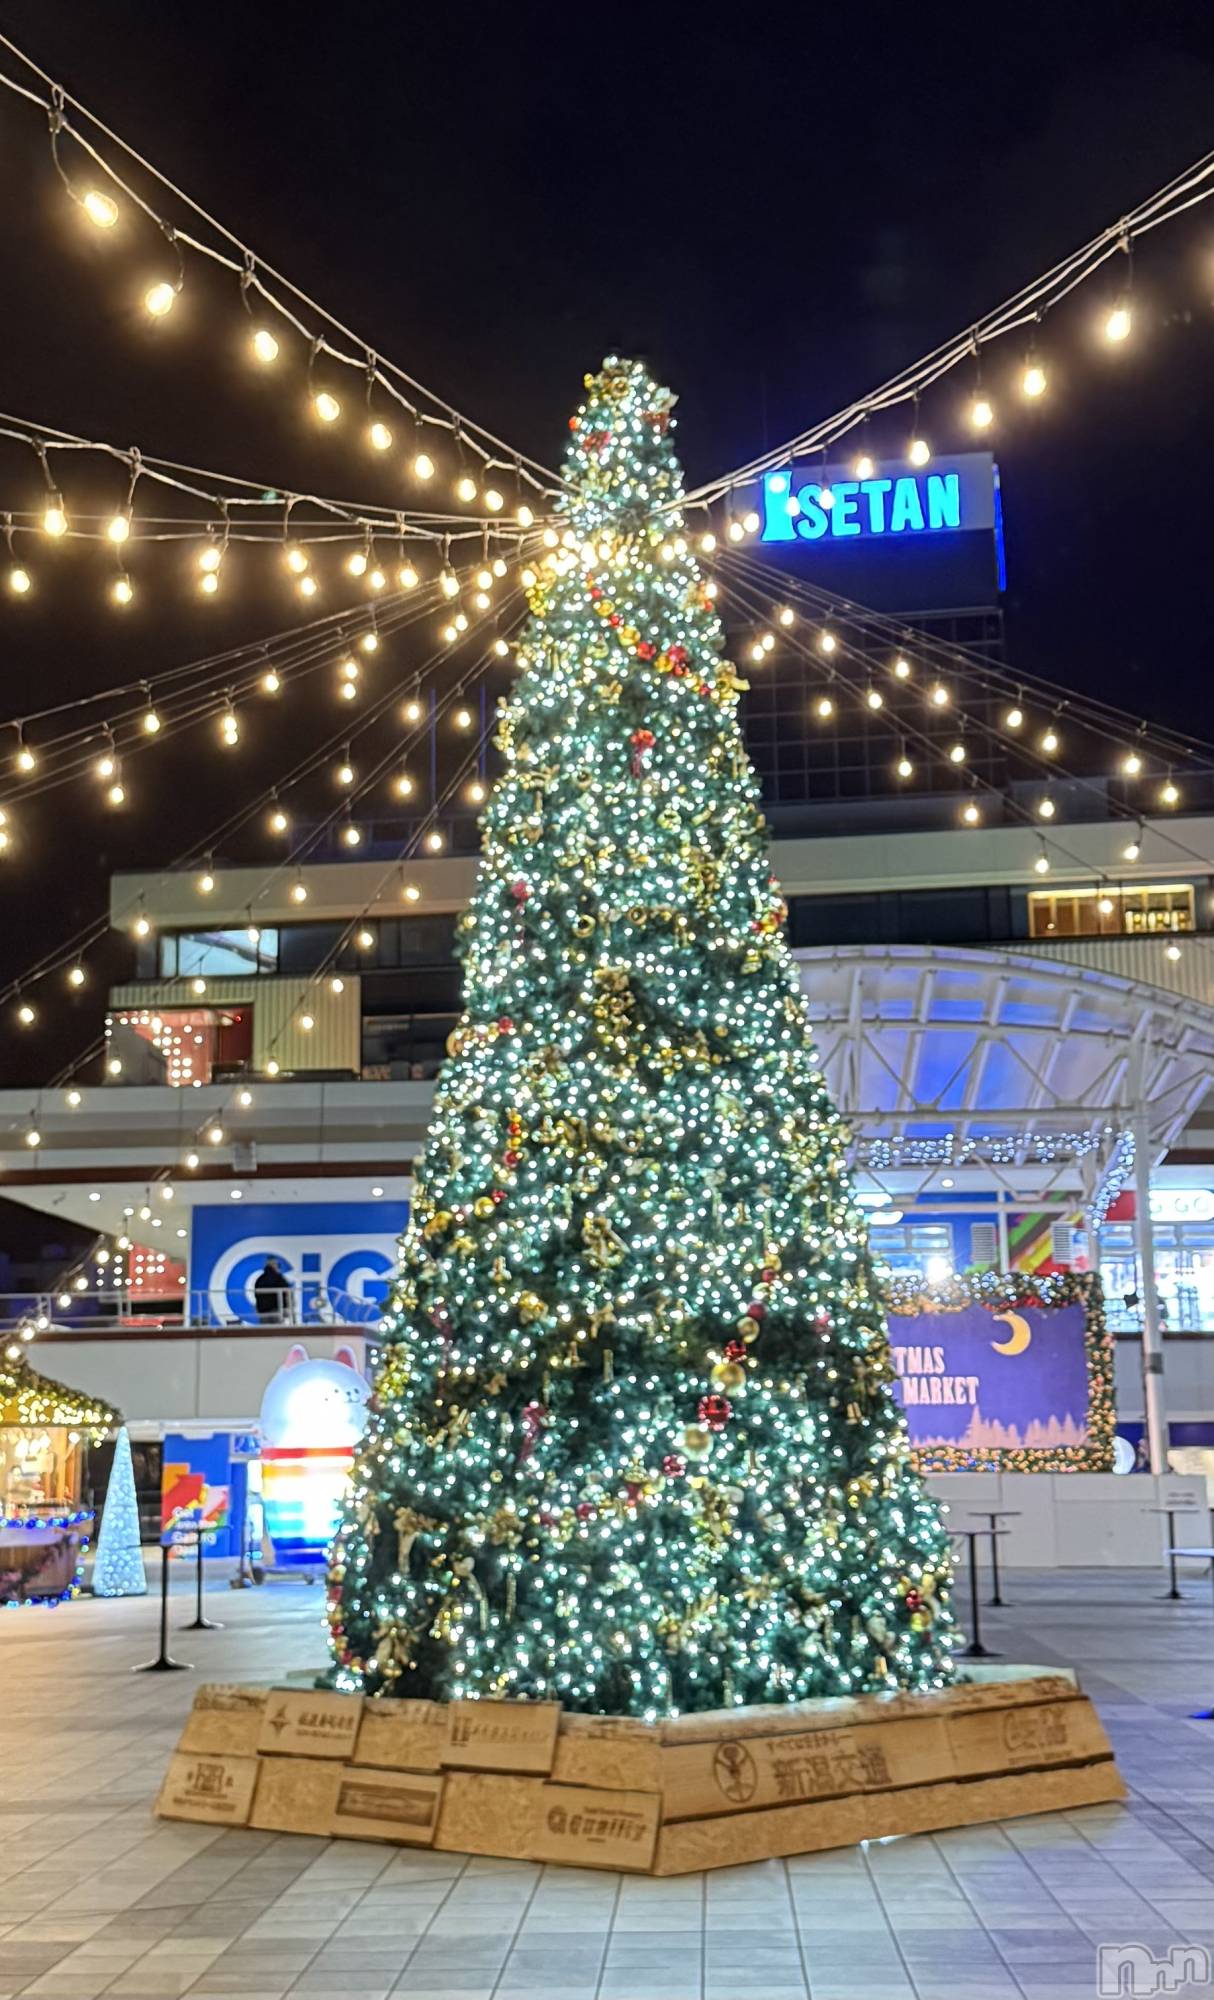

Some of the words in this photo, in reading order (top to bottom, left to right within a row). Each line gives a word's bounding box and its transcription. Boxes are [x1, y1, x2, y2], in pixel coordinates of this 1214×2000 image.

[761, 470, 960, 542] ISETAN
[901, 1376, 980, 1406] MARKET
[772, 1743, 893, 1796] 新潟交通
